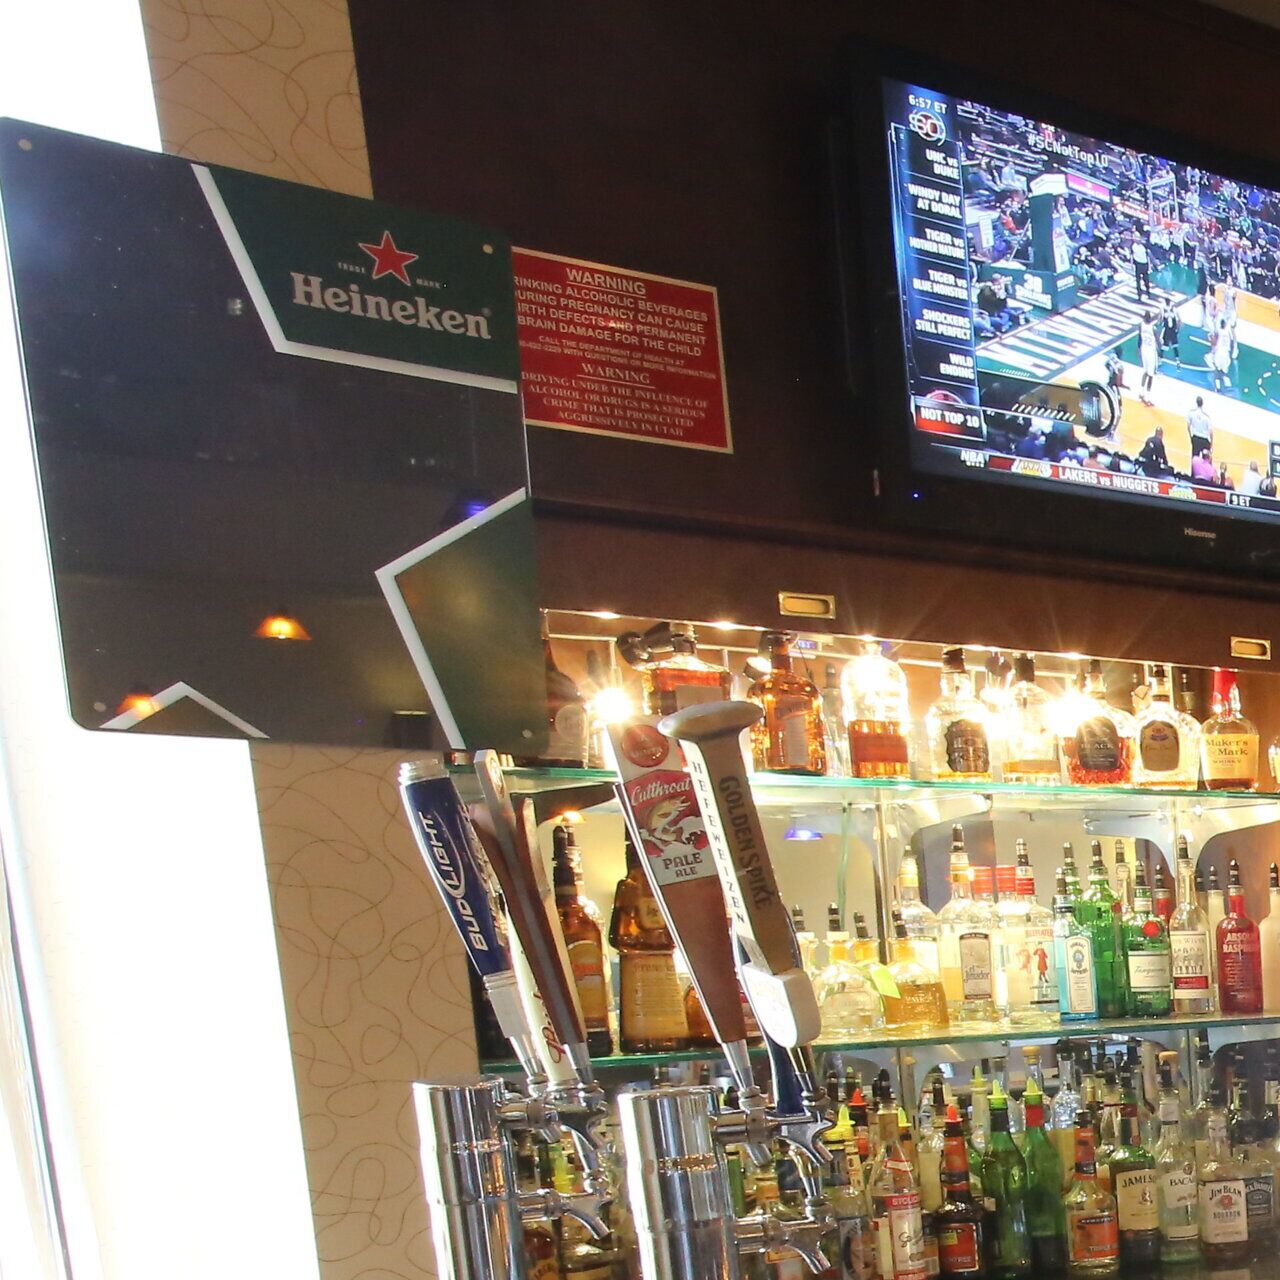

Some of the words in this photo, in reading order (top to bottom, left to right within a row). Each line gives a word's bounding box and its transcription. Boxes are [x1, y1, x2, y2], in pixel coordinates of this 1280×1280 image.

[908, 95, 931, 109] 6:57
[934, 101, 948, 115] ET
[926, 149, 946, 164] UNC
[947, 155, 958, 166] vs
[1027, 133, 1109, 168] #SCNotTop10
[934, 163, 959, 180] DUKE
[907, 183, 941, 203] WINDY
[942, 191, 961, 206] DAY
[917, 199, 930, 210] AT
[931, 202, 962, 219] DORAL
[909, 236, 936, 255] MOTHER
[937, 242, 965, 260] NATURE
[925, 228, 952, 245] TIGER
[953, 236, 964, 248] vs
[416, 278, 442, 289] MARK
[566, 268, 646, 295] WARNING
[913, 278, 933, 291] BLUE
[934, 282, 969, 300] MONSTER
[928, 269, 955, 285] TIGER
[956, 278, 967, 289] vs
[290, 272, 492, 339] Heineken
[513, 276, 562, 295] RINKING
[565, 287, 634, 308] ALCOHOLIC
[638, 300, 708, 322] BEVERAGES
[515, 290, 557, 306] URING
[560, 298, 634, 320] PREGNANCY
[638, 314, 663, 326] CAN
[665, 317, 704, 333] CAUSE
[922, 309, 970, 327] SHOCKERS
[517, 303, 546, 316] IRTH
[549, 308, 605, 328] DEFECTS
[609, 320, 634, 333] AND
[636, 325, 706, 346] PERMANENT
[915, 319, 938, 333] STILL
[938, 322, 971, 340] PERFECT
[517, 315, 556, 331] BRAIN
[559, 323, 612, 342] DAMAGE
[614, 333, 638, 345] FOR
[642, 338, 665, 351] THE
[668, 342, 701, 357] CHILD
[539, 335, 560, 345] CALL
[562, 339, 577, 349] THE
[579, 342, 630, 358] DEPARTMENT
[632, 351, 642, 359] OF
[644, 353, 673, 366] HEALTH
[949, 353, 973, 366] WILD
[564, 346, 584, 358] WITH
[630, 359, 641, 367] OR
[643, 361, 665, 371] MORE
[666, 363, 716, 380] INFORMATION
[582, 363, 650, 385] WARNING
[940, 363, 975, 380] ENDING
[521, 371, 569, 387] DRIVING
[572, 378, 608, 393] UNDER
[612, 385, 632, 396] THE
[635, 389, 692, 406] INFLUENCE
[695, 399, 709, 409] OF
[528, 384, 581, 401] ALCOHOL
[585, 394, 600, 403] OR
[603, 395, 638, 409] DRUGS
[641, 402, 650, 410] IS
[654, 403, 661, 411] A
[663, 404, 705, 418] SERIOUS
[543, 397, 580, 411] CRIME
[583, 403, 610, 416] THAT
[614, 408, 624, 418] IS
[626, 410, 694, 427] PROSECUTED
[920, 406, 942, 421] NOT
[944, 409, 965, 425] TOP
[966, 416, 979, 429] 10
[558, 411, 638, 431] AGGRESSIVELY
[641, 422, 651, 431] IN
[654, 424, 684, 437] UTAH
[960, 450, 984, 463] NBA
[1058, 467, 1097, 485] LAKERS
[1100, 474, 1111, 487] vs
[1113, 475, 1160, 494] NUGGETS
[1232, 492, 1238, 504] 9
[1240, 495, 1251, 507] ET
[1184, 527, 1217, 540] Hisense
[1205, 738, 1248, 748] Maker's
[1218, 748, 1248, 756] Mark
[631, 777, 691, 807] Cutthroat
[419, 811, 460, 887] LIGHT
[692, 761, 744, 924] HEFEWEIZEN
[719, 775, 755, 851] GOLDEN
[742, 851, 773, 910] SPIKE
[662, 852, 703, 870] PALE
[675, 866, 698, 878] ALE
[456, 898, 488, 951] BUD
[1122, 1174, 1156, 1188] JAMES
[1170, 1176, 1195, 1187] BACA
[1209, 1188, 1222, 1200] JIM
[1223, 1185, 1242, 1197] BEAM
